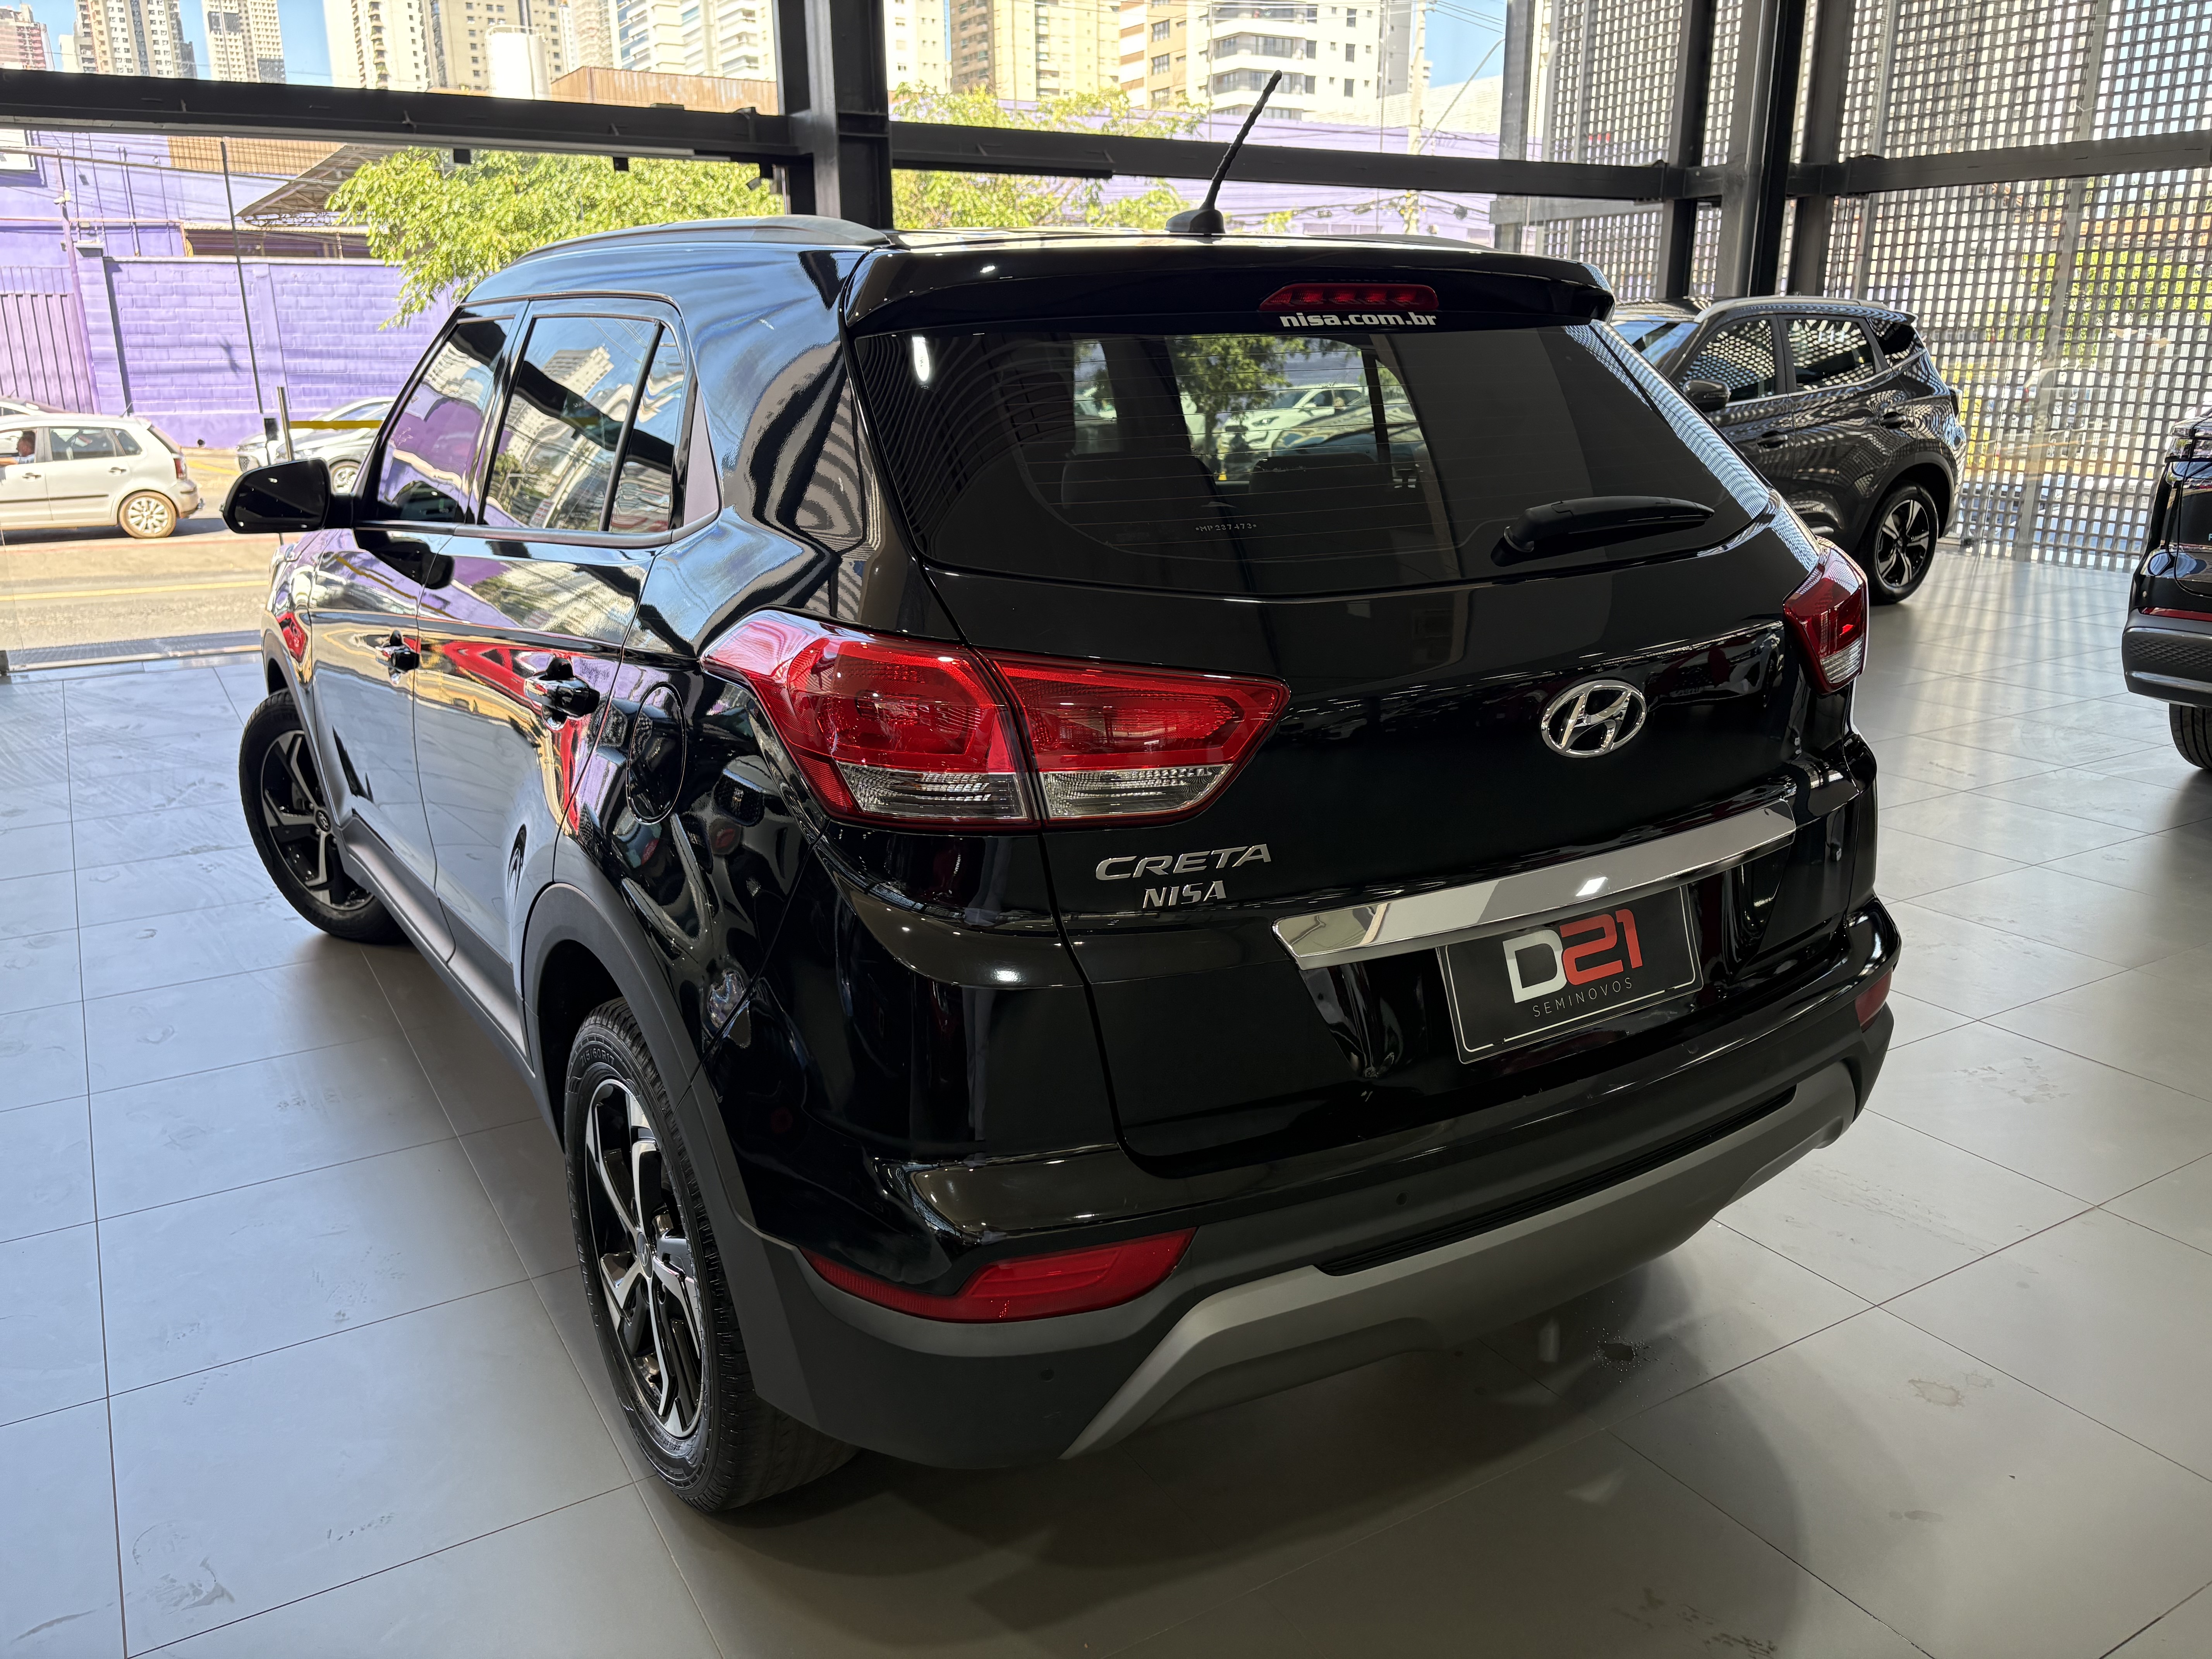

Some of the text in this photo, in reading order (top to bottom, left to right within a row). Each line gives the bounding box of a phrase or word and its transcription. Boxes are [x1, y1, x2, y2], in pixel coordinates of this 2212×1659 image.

[1279, 312, 1436, 327] nisa.com.br
[1096, 843, 1271, 881] CRETA
[1142, 880, 1227, 908] NISA
[1502, 908, 1643, 1003] D21
[1533, 977, 1633, 1017] SEMINOVOS
